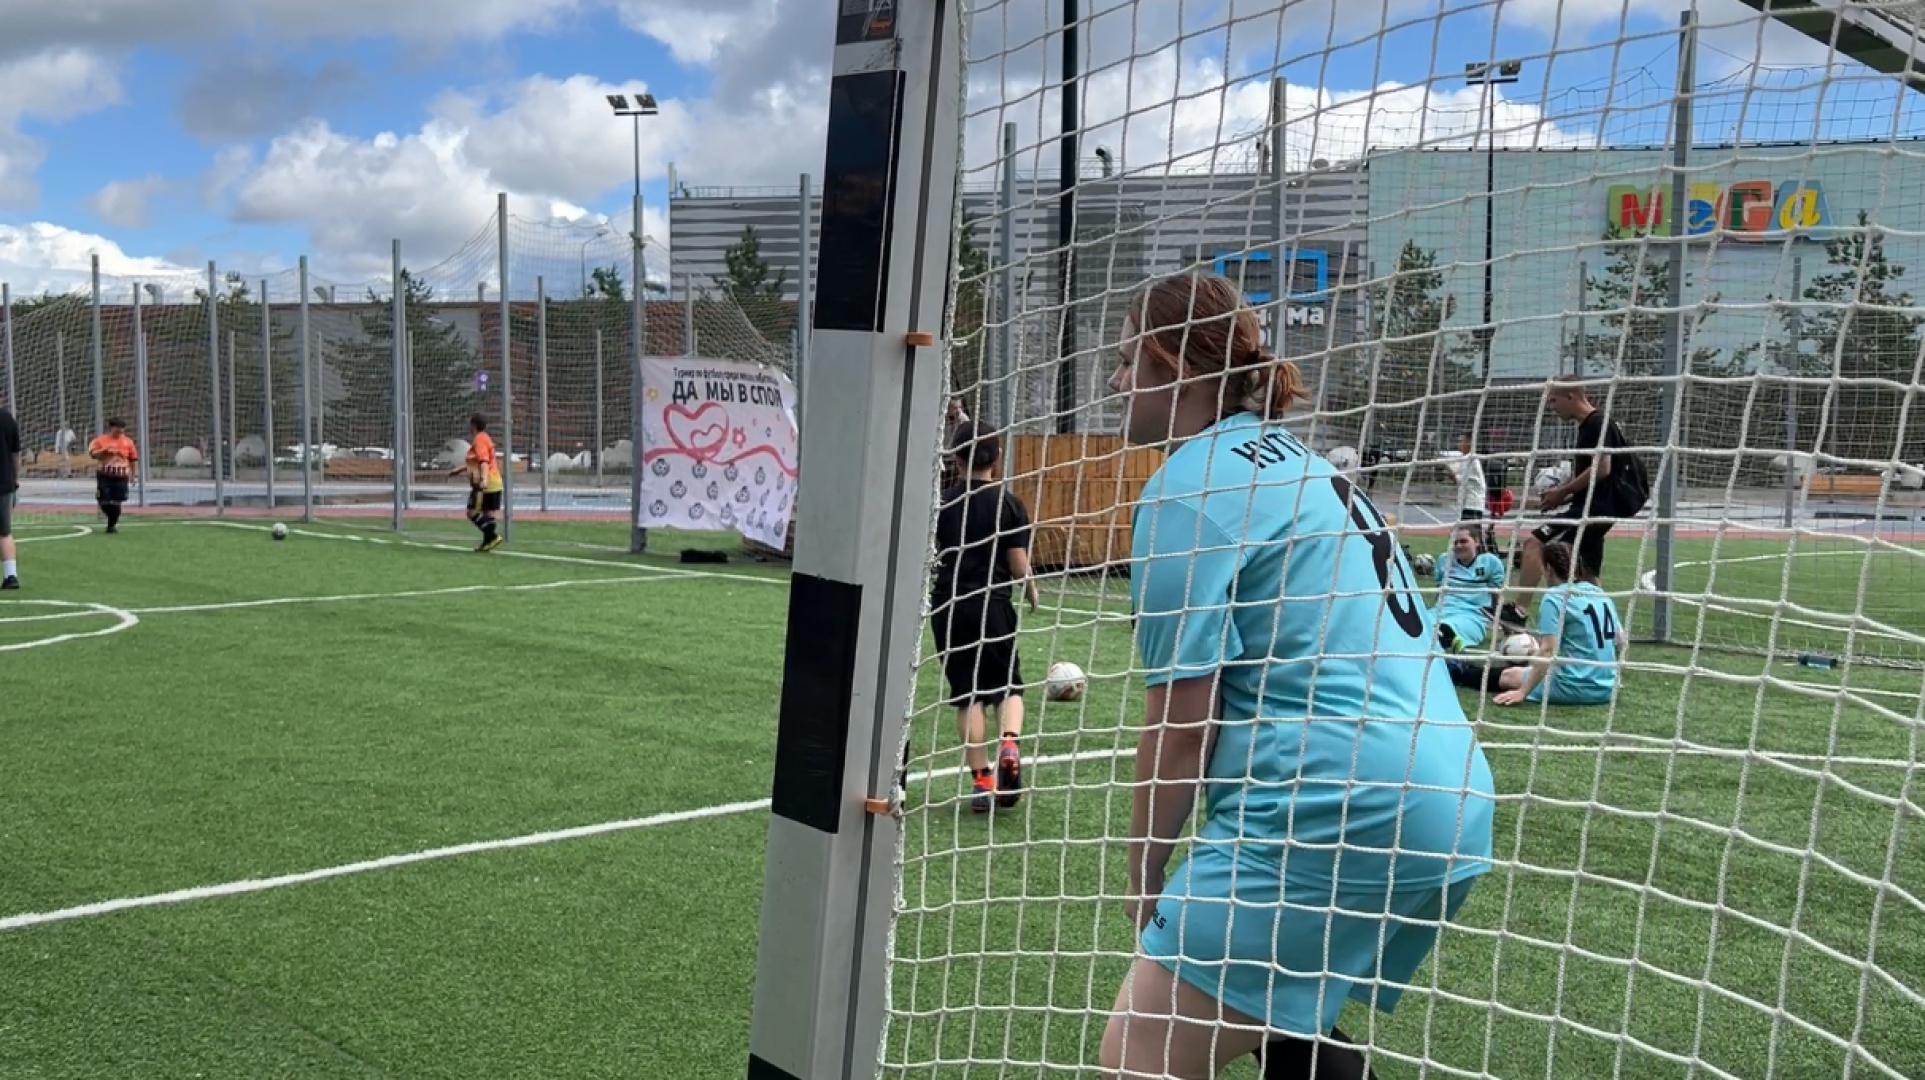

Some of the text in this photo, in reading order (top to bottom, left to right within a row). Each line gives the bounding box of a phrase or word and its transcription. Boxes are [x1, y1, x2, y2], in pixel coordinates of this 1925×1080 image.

[672, 380, 699, 405] ДА
[706, 382, 735, 403] МЫ
[738, 383, 748, 403] В
[1330, 474, 1424, 638] 8
[1582, 602, 1616, 650] 14
